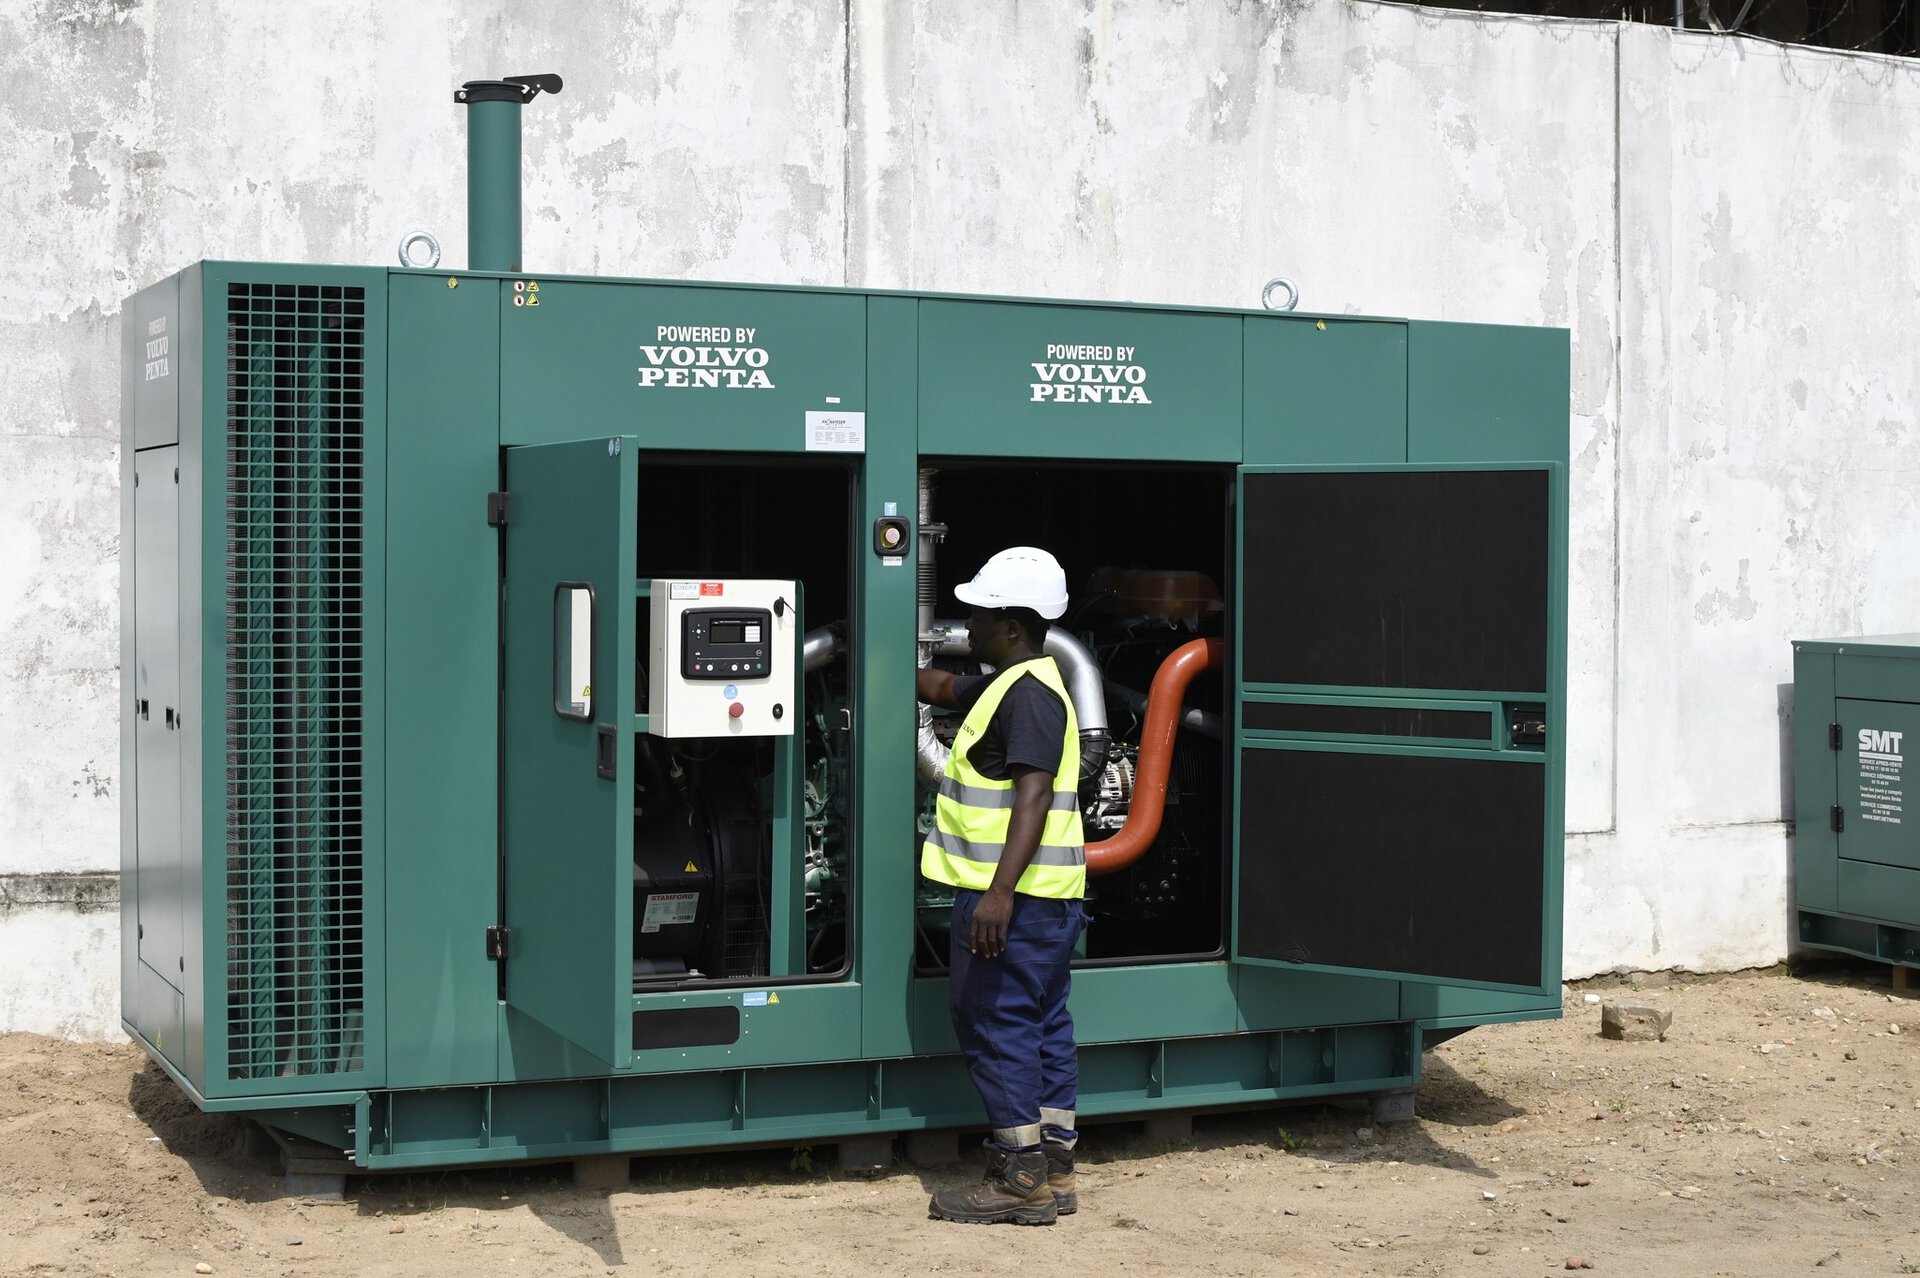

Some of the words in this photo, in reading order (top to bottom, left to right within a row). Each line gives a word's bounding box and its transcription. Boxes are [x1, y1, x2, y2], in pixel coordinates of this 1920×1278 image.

[657, 325, 731, 344] POWERED
[736, 328, 756, 344] BY
[146, 335, 169, 360] VOLVO
[639, 345, 770, 368] VOLVO
[1047, 344, 1112, 361] POWERED
[1117, 346, 1135, 362] BY
[145, 357, 169, 382] PENTA
[638, 367, 776, 389] PENTA
[1031, 363, 1147, 384] VOLVO
[1030, 383, 1152, 405] PENTA
[1858, 728, 1903, 754] SMT
[651, 893, 693, 901] STAMFORD
